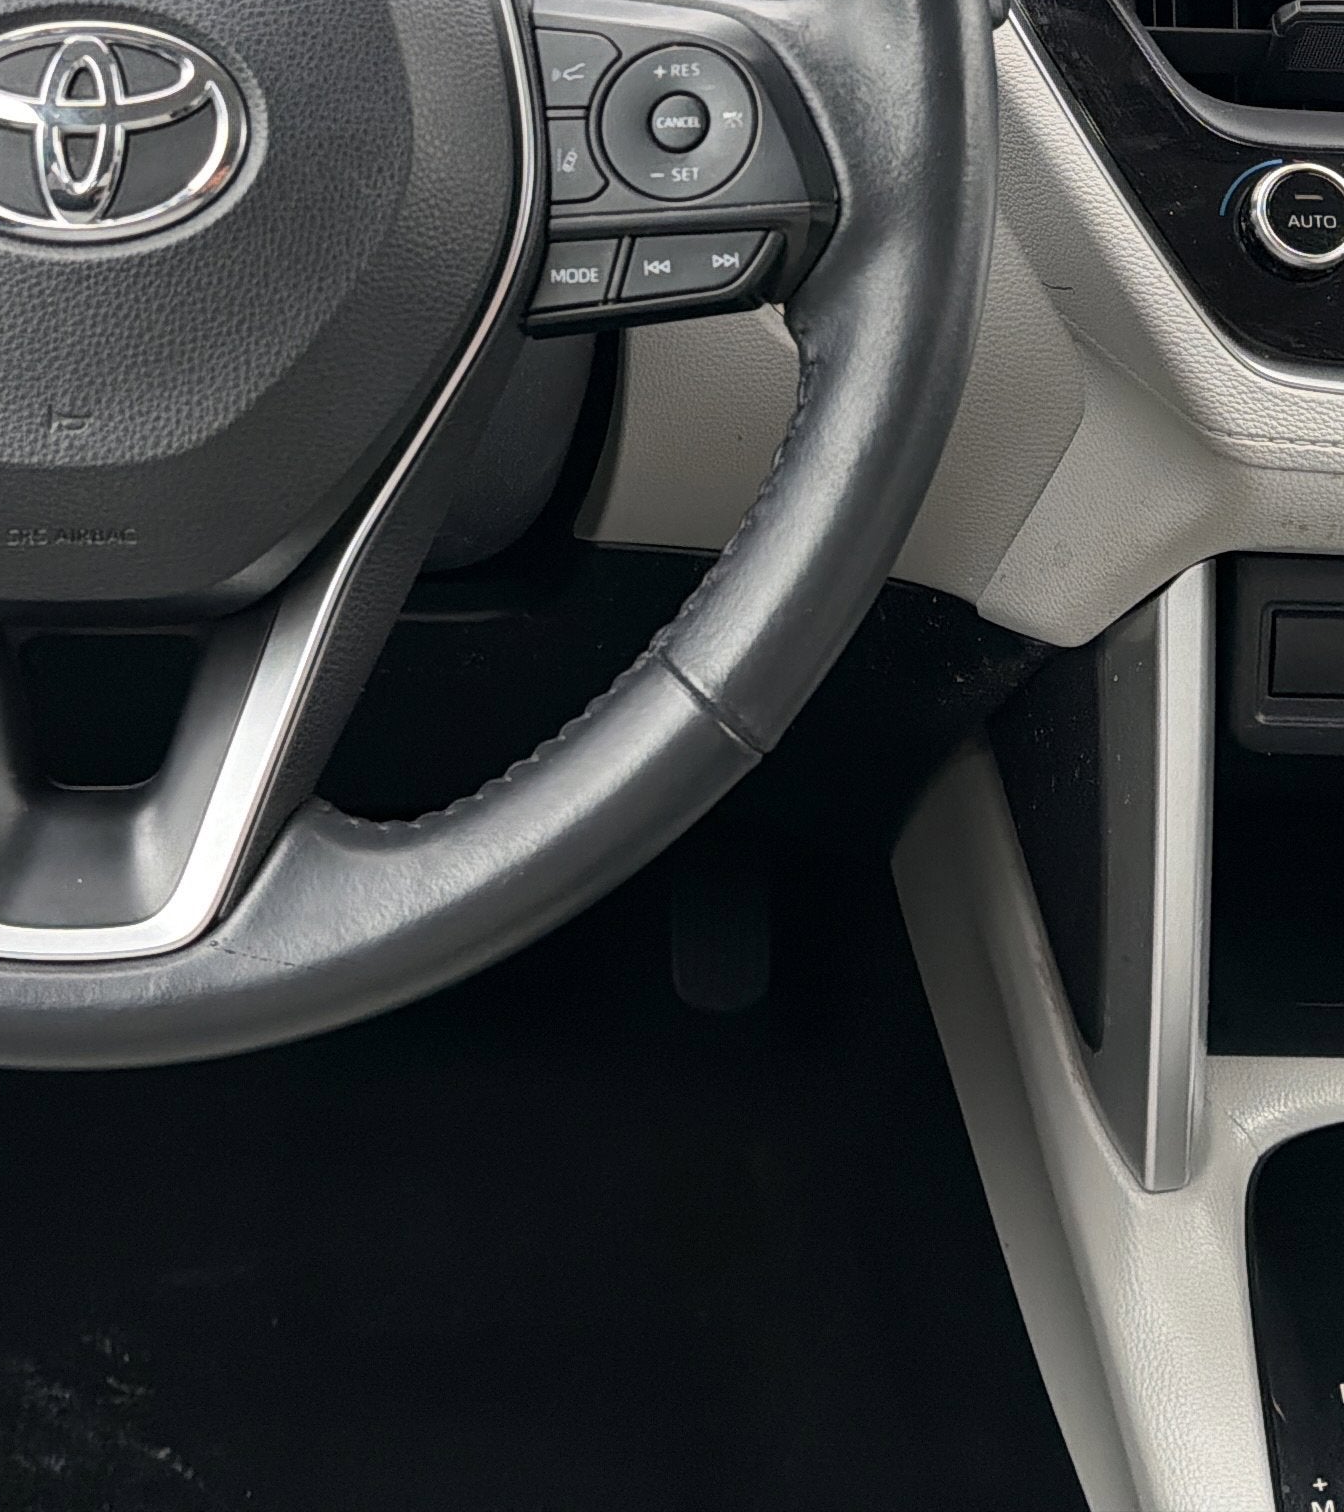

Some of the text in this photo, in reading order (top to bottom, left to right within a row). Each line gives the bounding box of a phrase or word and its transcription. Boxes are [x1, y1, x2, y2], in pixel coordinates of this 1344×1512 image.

[670, 62, 701, 78] RES
[656, 115, 702, 130] CANCEL
[671, 167, 700, 182] SET
[1287, 214, 1337, 229] AUTO
[550, 268, 600, 285] MODE
